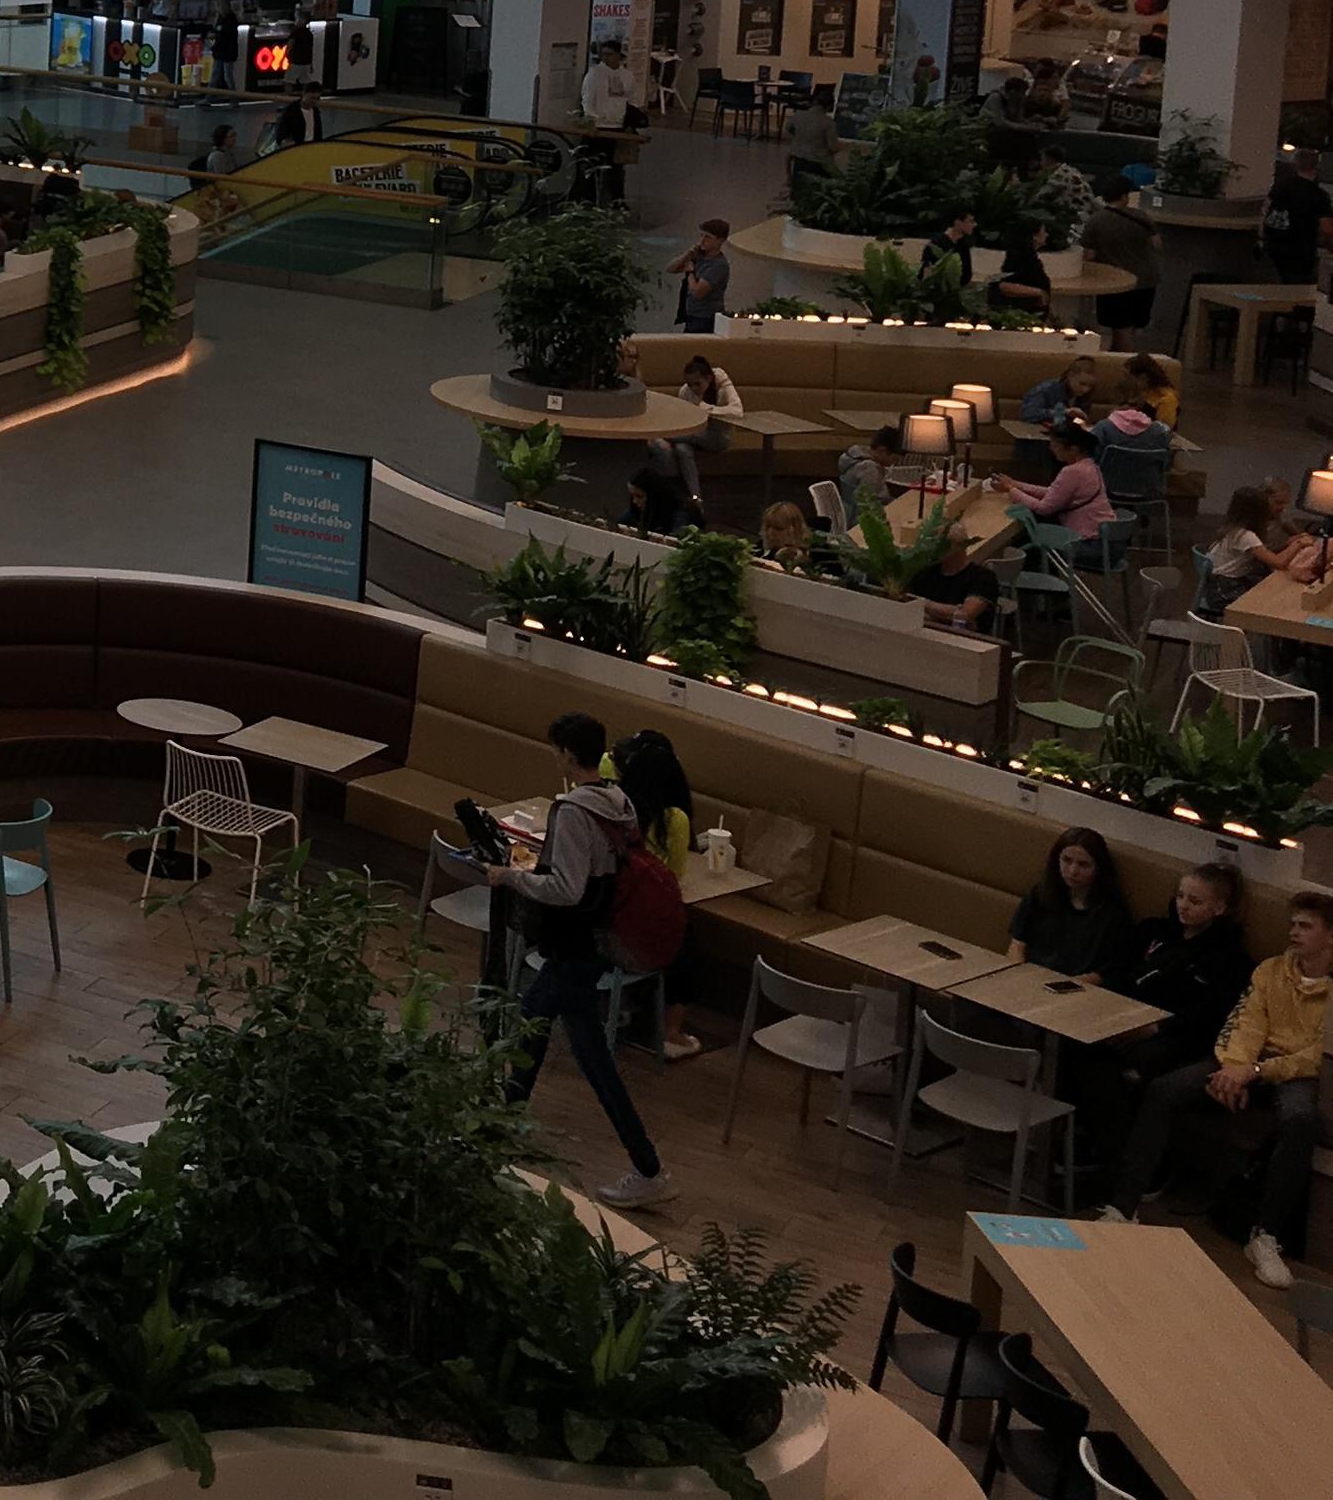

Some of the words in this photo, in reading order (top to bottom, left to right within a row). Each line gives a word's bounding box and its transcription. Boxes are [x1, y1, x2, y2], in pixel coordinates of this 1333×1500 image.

[594, 4, 631, 18] SHAKES
[282, 491, 341, 513] Pravidla
[269, 504, 353, 531] bezpečného
